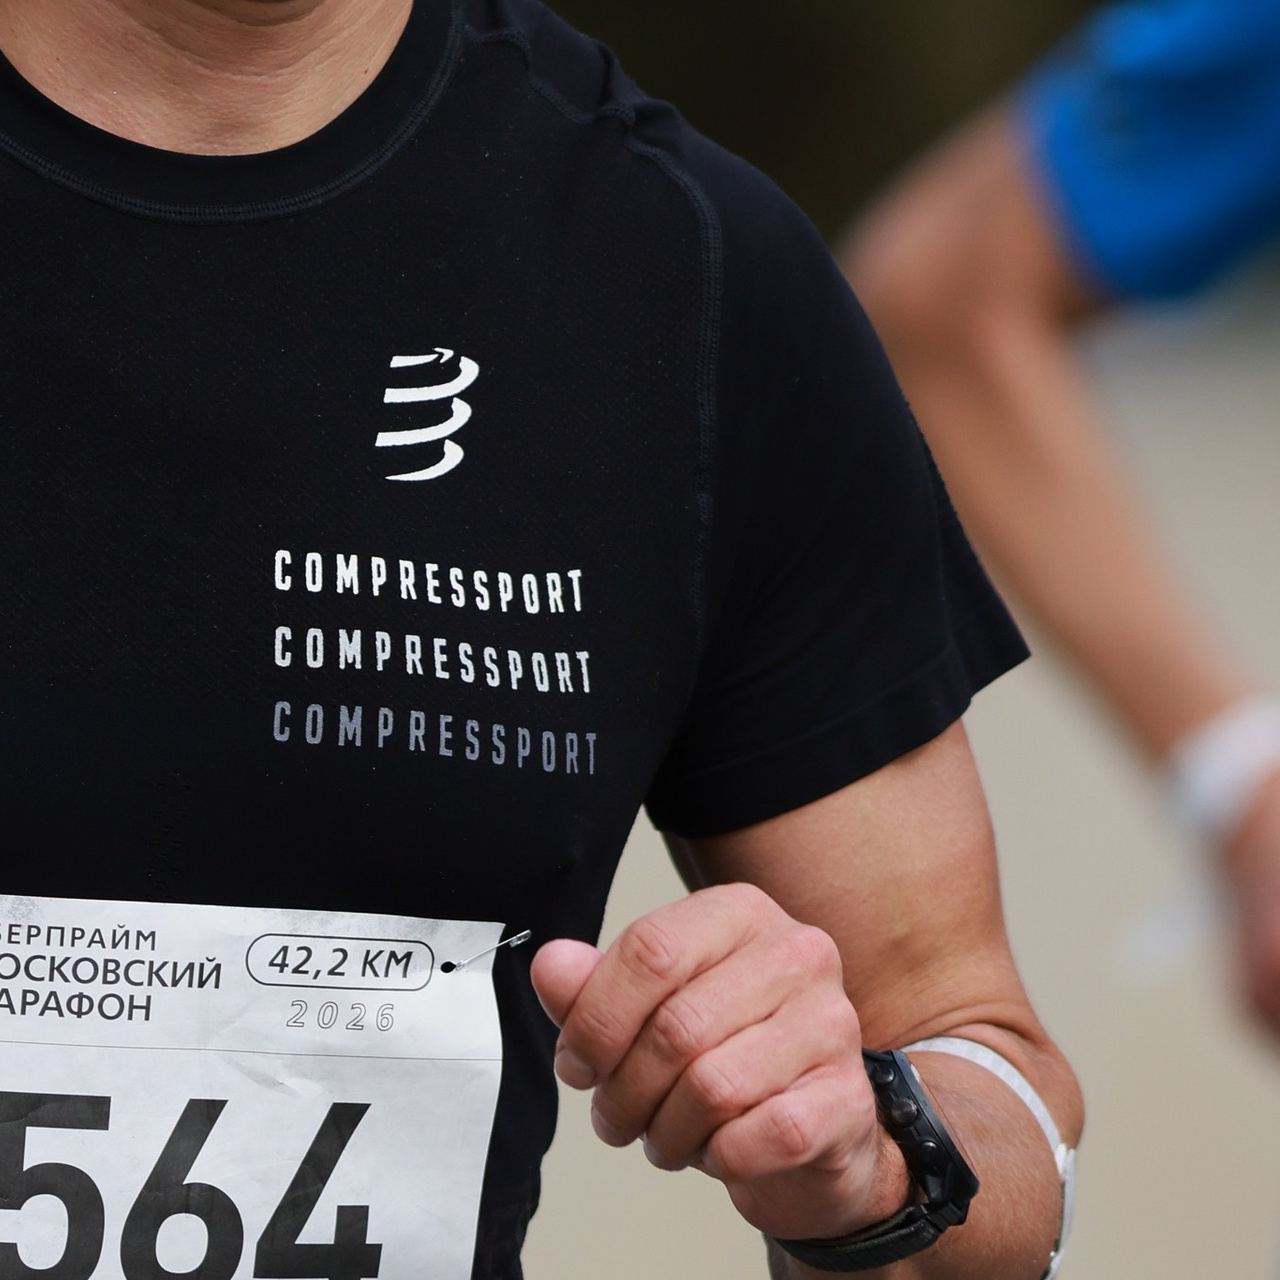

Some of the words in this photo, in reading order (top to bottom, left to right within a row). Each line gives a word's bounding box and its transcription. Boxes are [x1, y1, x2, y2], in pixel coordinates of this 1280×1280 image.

[274, 549, 582, 614] COMPRESSPORT
[274, 626, 590, 693] COMPRESSPORT
[272, 700, 597, 775] COMPRESSPORT
[268, 945, 349, 980] 42,2
[286, 999, 395, 1032] 2026
